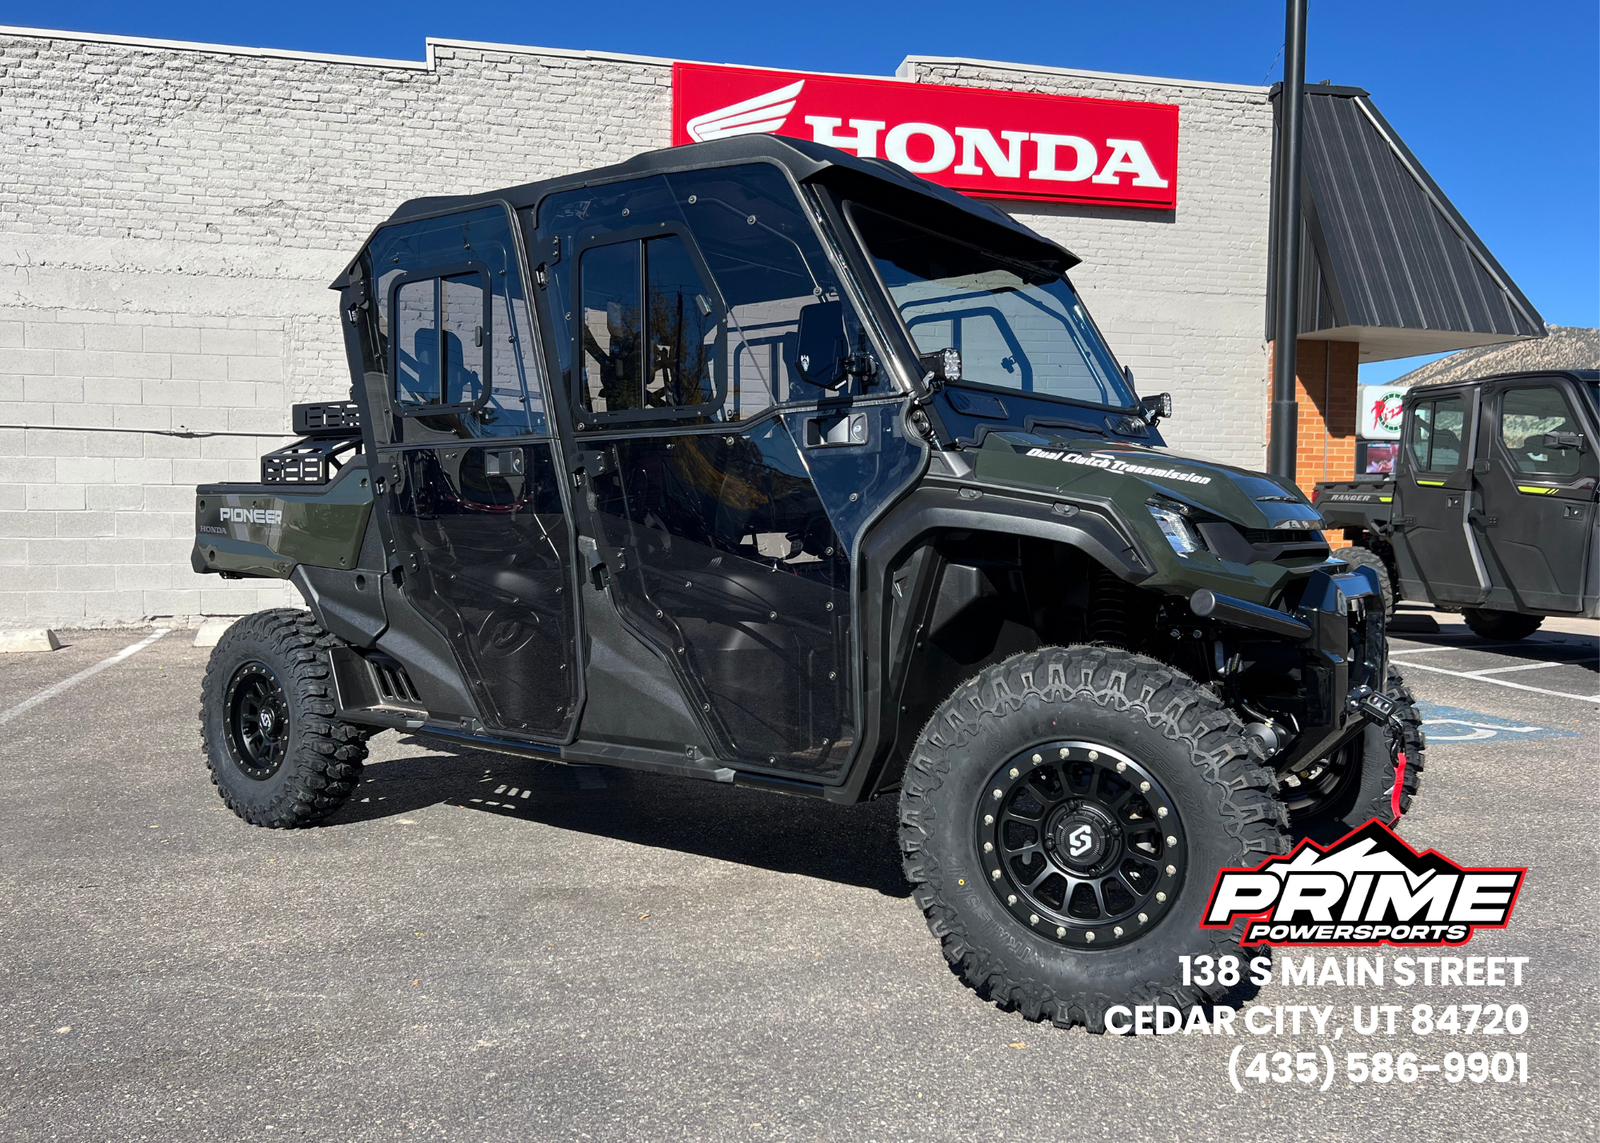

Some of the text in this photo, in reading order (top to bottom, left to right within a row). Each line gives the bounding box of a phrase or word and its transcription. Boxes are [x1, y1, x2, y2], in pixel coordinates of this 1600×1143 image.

[804, 114, 1169, 189] HONDA
[1370, 400, 1403, 430] Pizz
[1025, 447, 1212, 485] Dual Clutch Transmission
[1330, 494, 1371, 502] RANGER
[219, 507, 282, 525] PIONEER
[199, 525, 228, 535] HONDA
